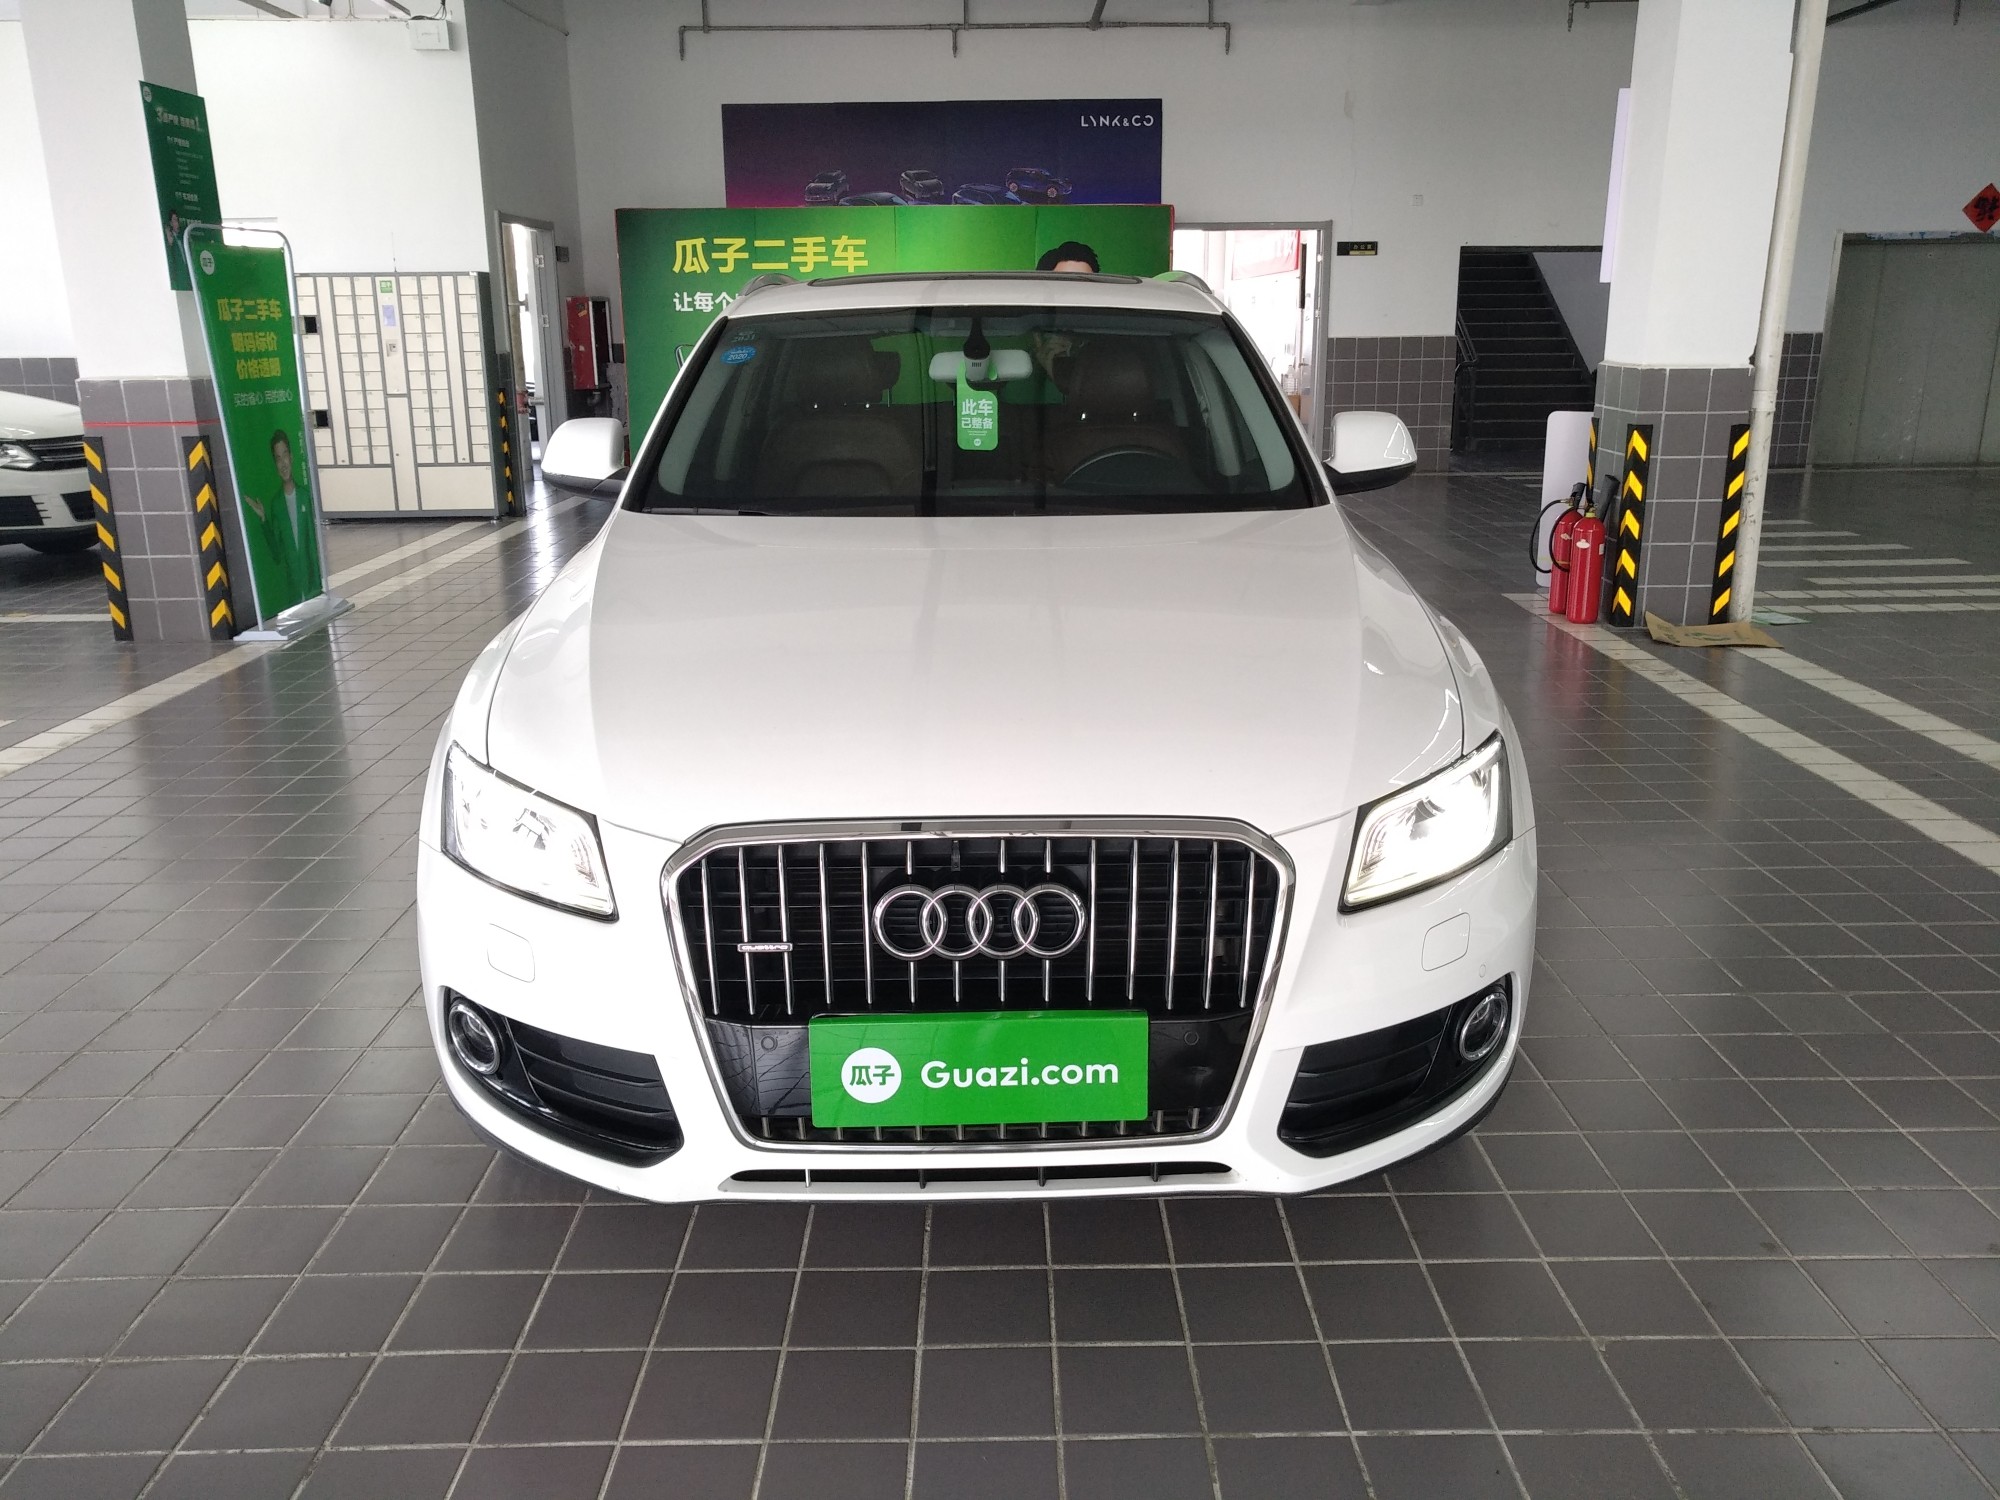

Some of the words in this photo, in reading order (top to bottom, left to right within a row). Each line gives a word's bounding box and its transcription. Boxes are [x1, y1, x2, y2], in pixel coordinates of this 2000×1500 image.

[672, 235, 869, 274] 瓜子二手车
[217, 298, 283, 322] 瓜子二手车
[673, 291, 739, 313] 让每个
[961, 398, 994, 417] 此车
[961, 417, 993, 430] 已整备
[849, 1064, 895, 1087] 瓜子
[920, 1057, 1119, 1089] Guazi.com
